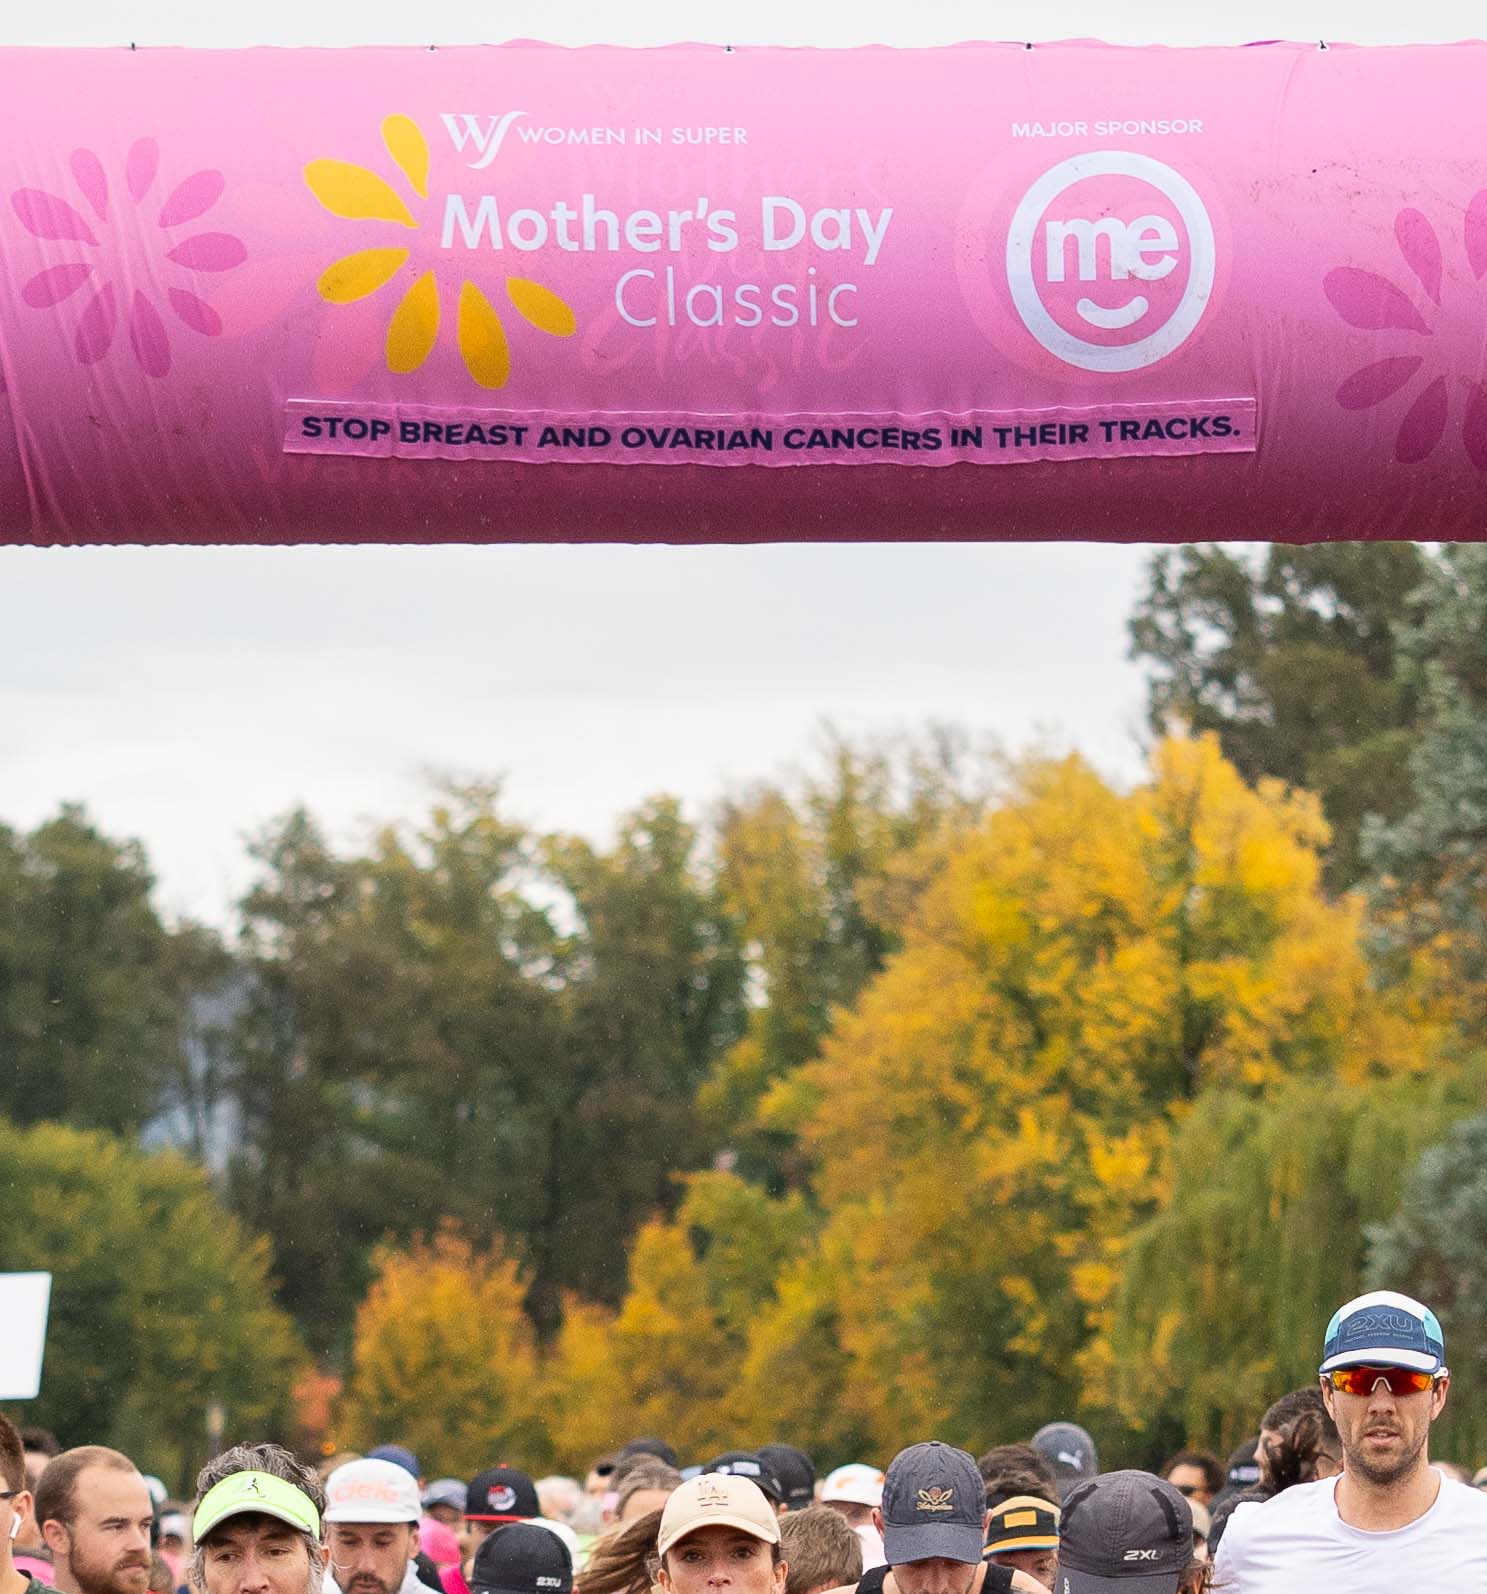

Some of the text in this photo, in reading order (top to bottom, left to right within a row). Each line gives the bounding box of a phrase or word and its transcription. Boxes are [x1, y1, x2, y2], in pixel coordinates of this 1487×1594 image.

[517, 126, 747, 146] WOMEN IN SUPER
[1012, 119, 1203, 137] MAJOR SPONSOR
[761, 196, 894, 265] Day
[1046, 215, 1179, 282] me
[615, 266, 858, 328] Classic
[301, 416, 1241, 452] STOP BREAST AND OVARIAN CANCERS IN THEIR TRACKS.
[1347, 1313, 1413, 1337] 2XU
